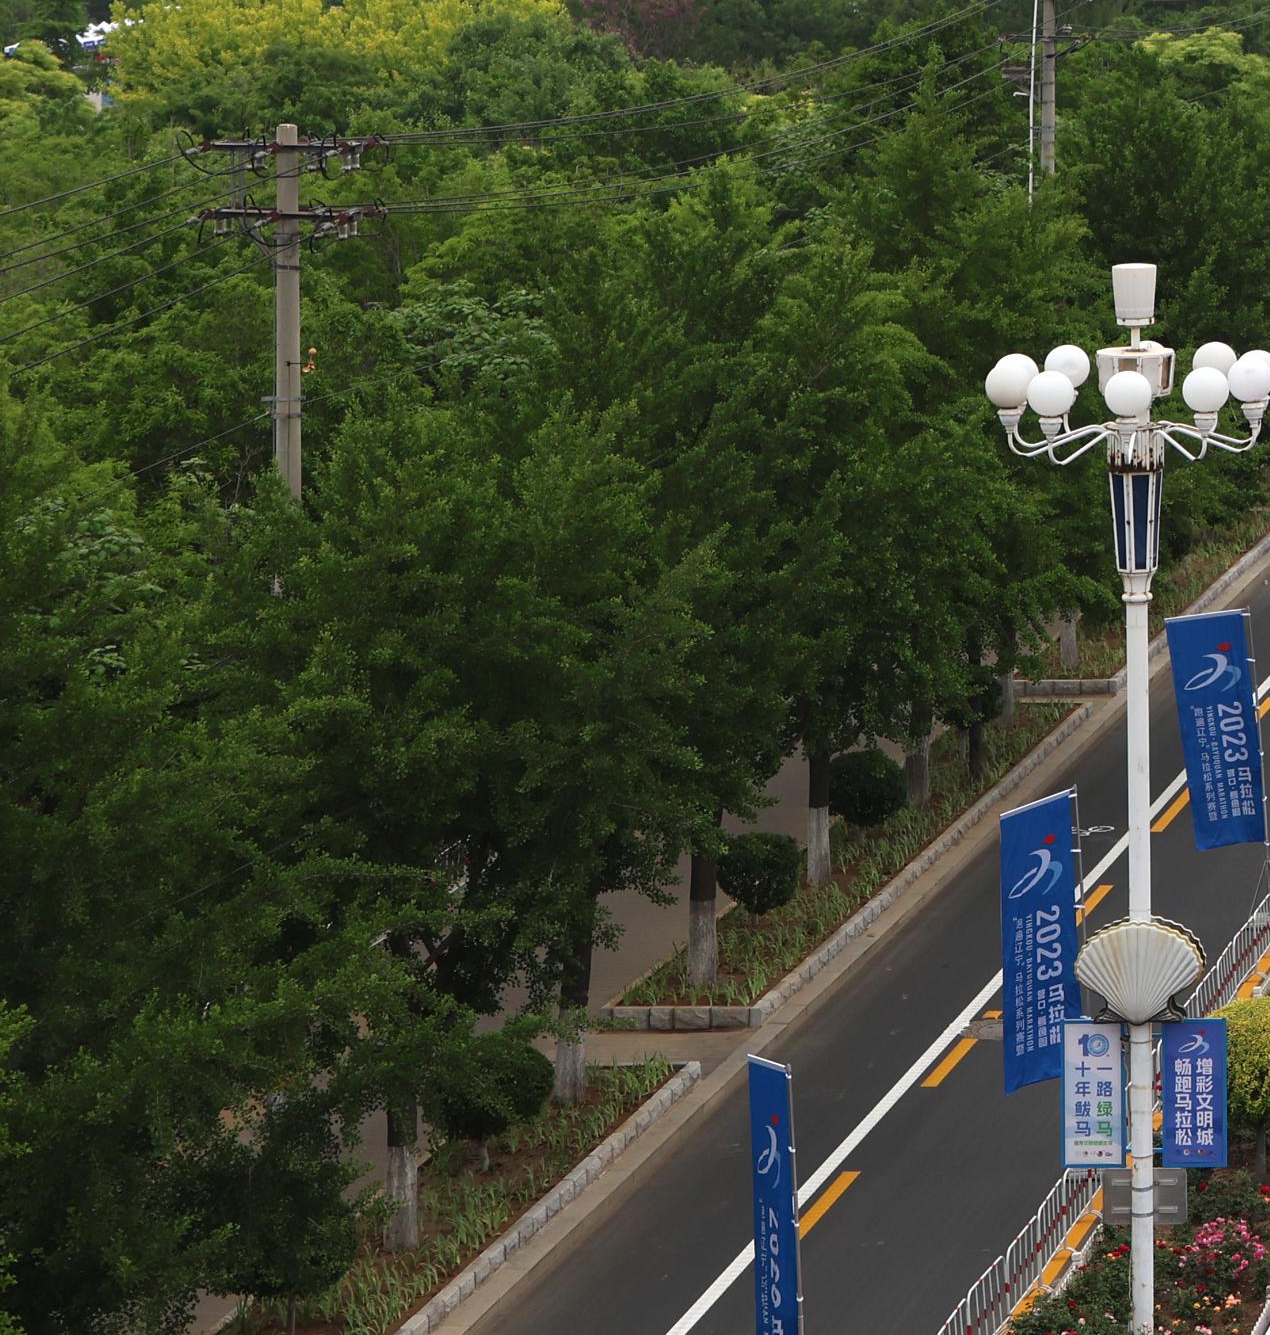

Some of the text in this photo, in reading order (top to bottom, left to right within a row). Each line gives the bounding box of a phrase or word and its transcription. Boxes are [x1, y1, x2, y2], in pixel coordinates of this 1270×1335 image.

[1217, 701, 1249, 762] 2023
[1217, 782, 1228, 819] MARATHON
[1238, 767, 1255, 815] 马拉松
[1036, 904, 1063, 981] 2023
[1026, 1006, 1035, 1052] MARATHON
[1078, 1033, 1110, 1057] 10
[1074, 1061, 1091, 1137] 十年鲅马
[1096, 1066, 1113, 1137] 一路绿马
[1174, 1058, 1192, 1146] 畅跑马拉松
[1195, 1058, 1214, 1146] 增彩文明城
